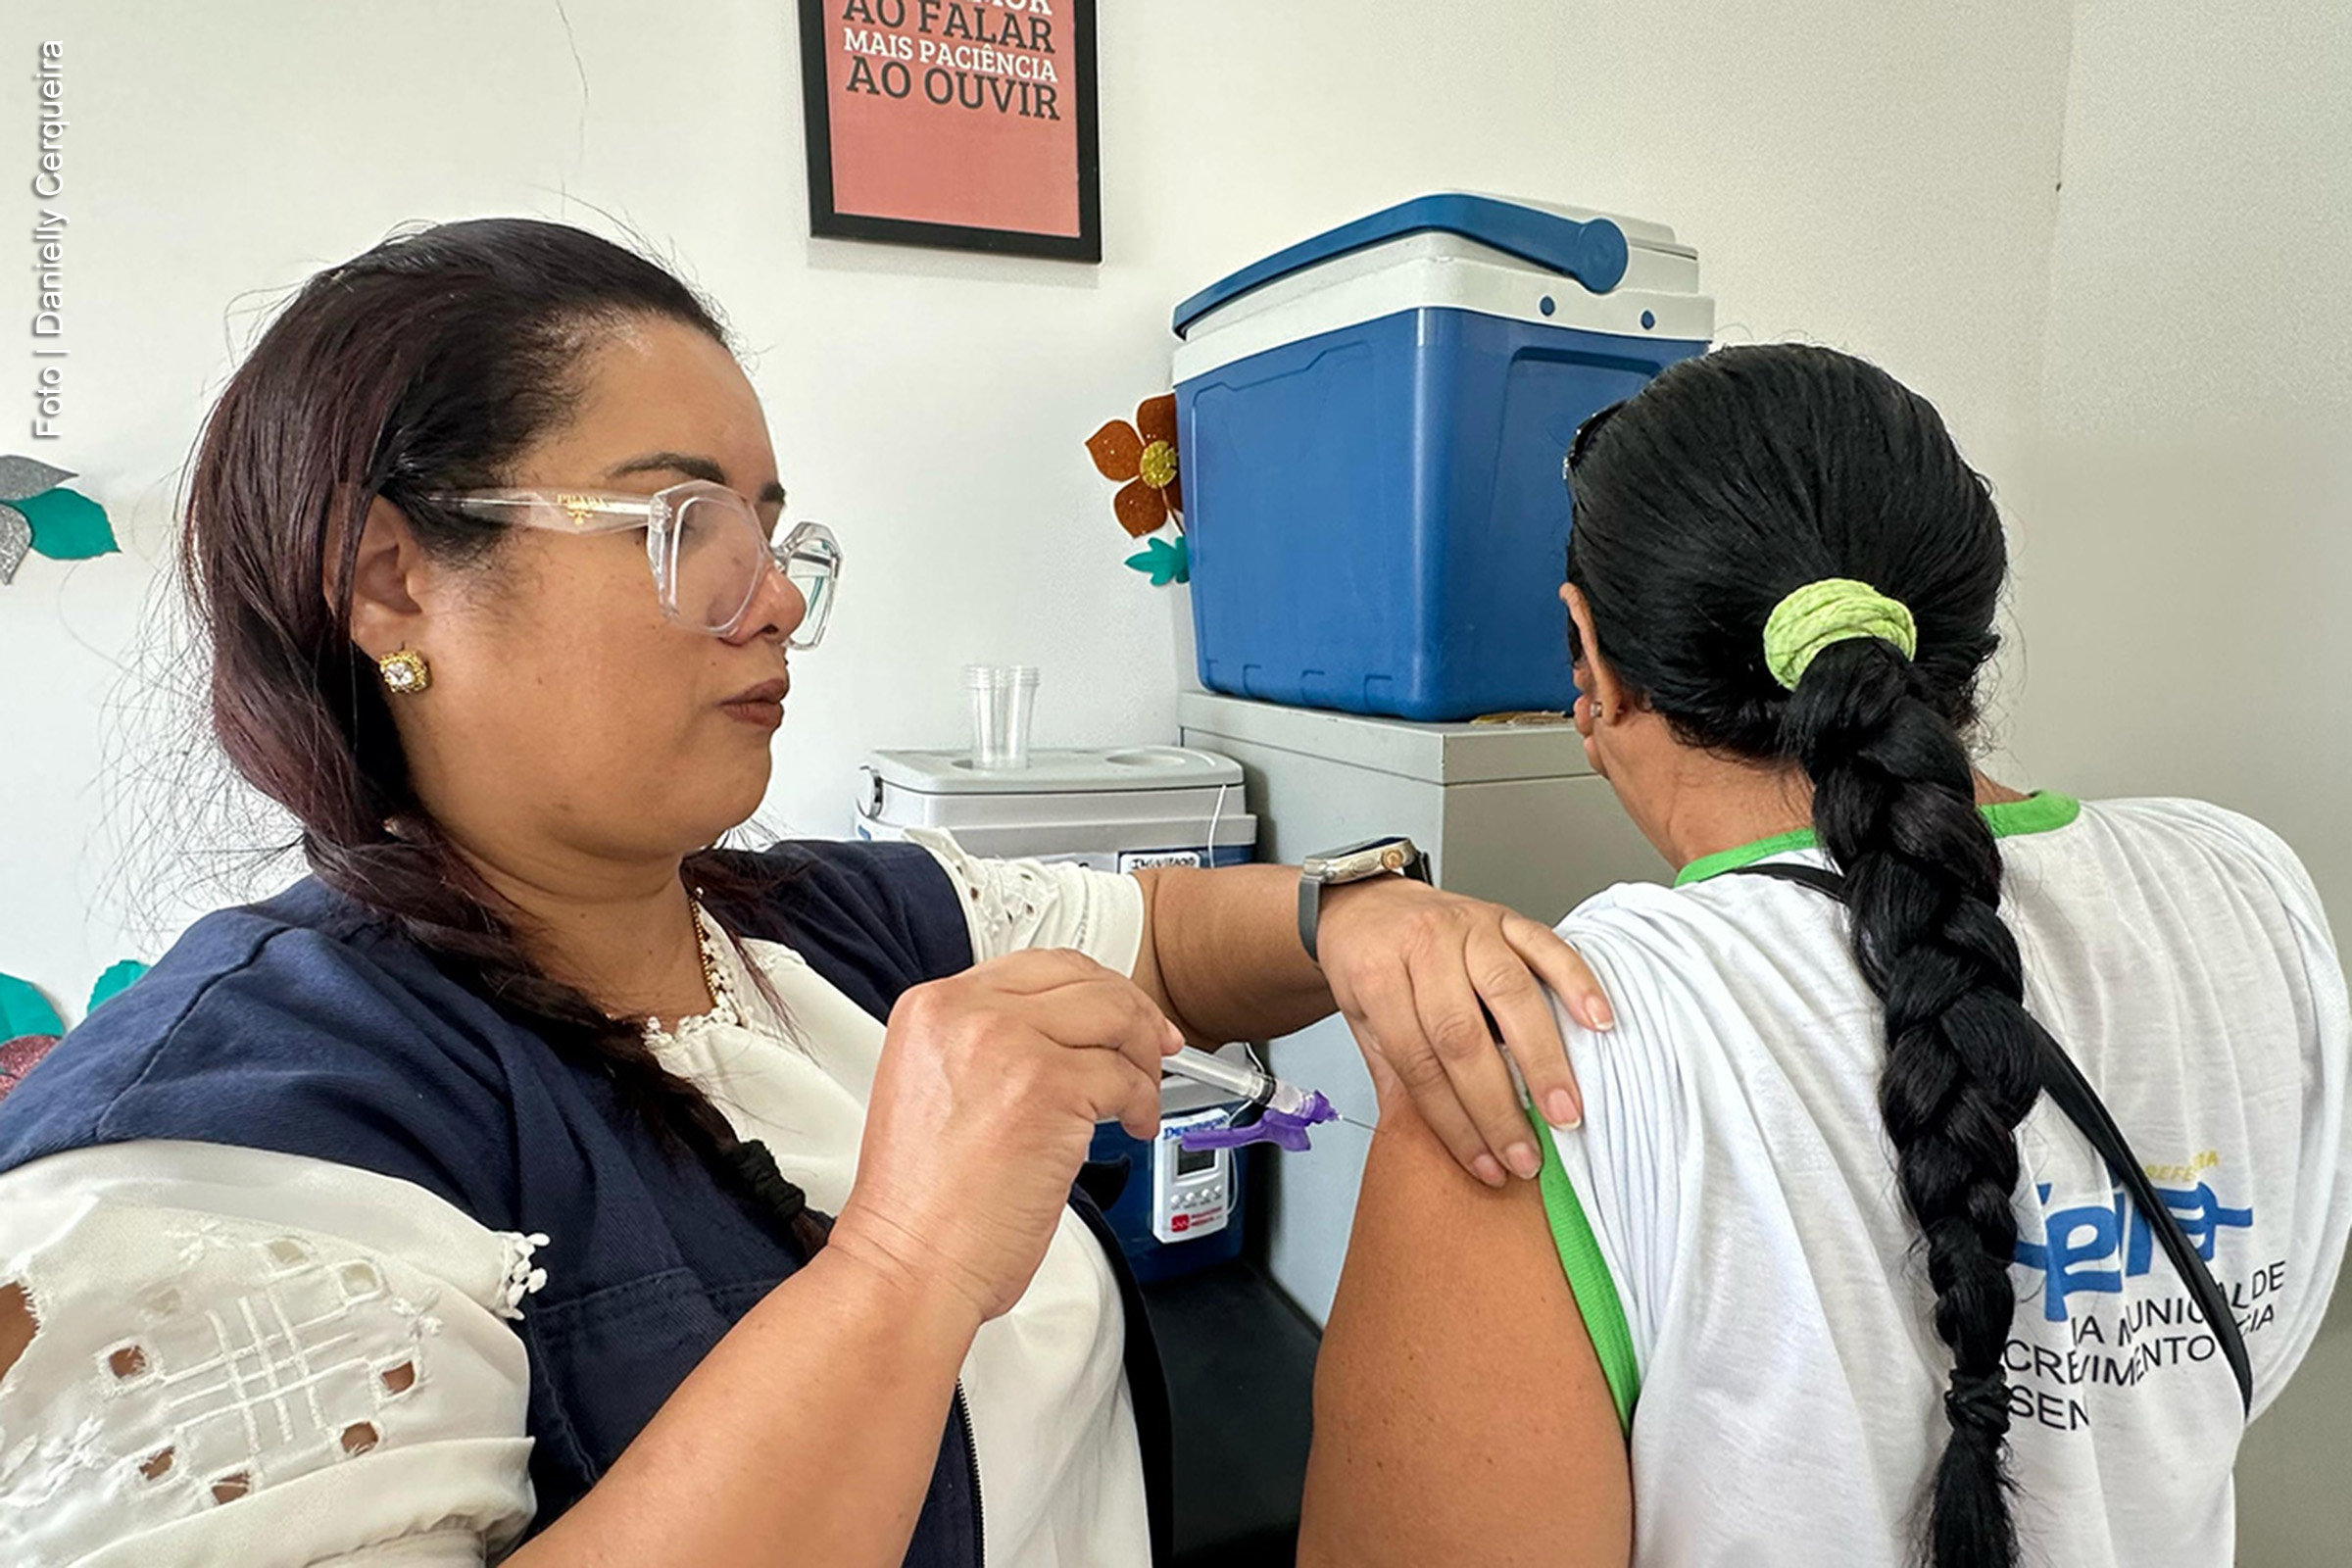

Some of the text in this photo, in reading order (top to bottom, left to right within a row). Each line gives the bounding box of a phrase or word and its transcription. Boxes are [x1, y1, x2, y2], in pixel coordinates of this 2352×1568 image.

[843, 0, 1055, 54] AO FALAR
[844, 27, 1057, 82] MAIS PACIÊNCIA
[846, 56, 1060, 121] AO OUVIR
